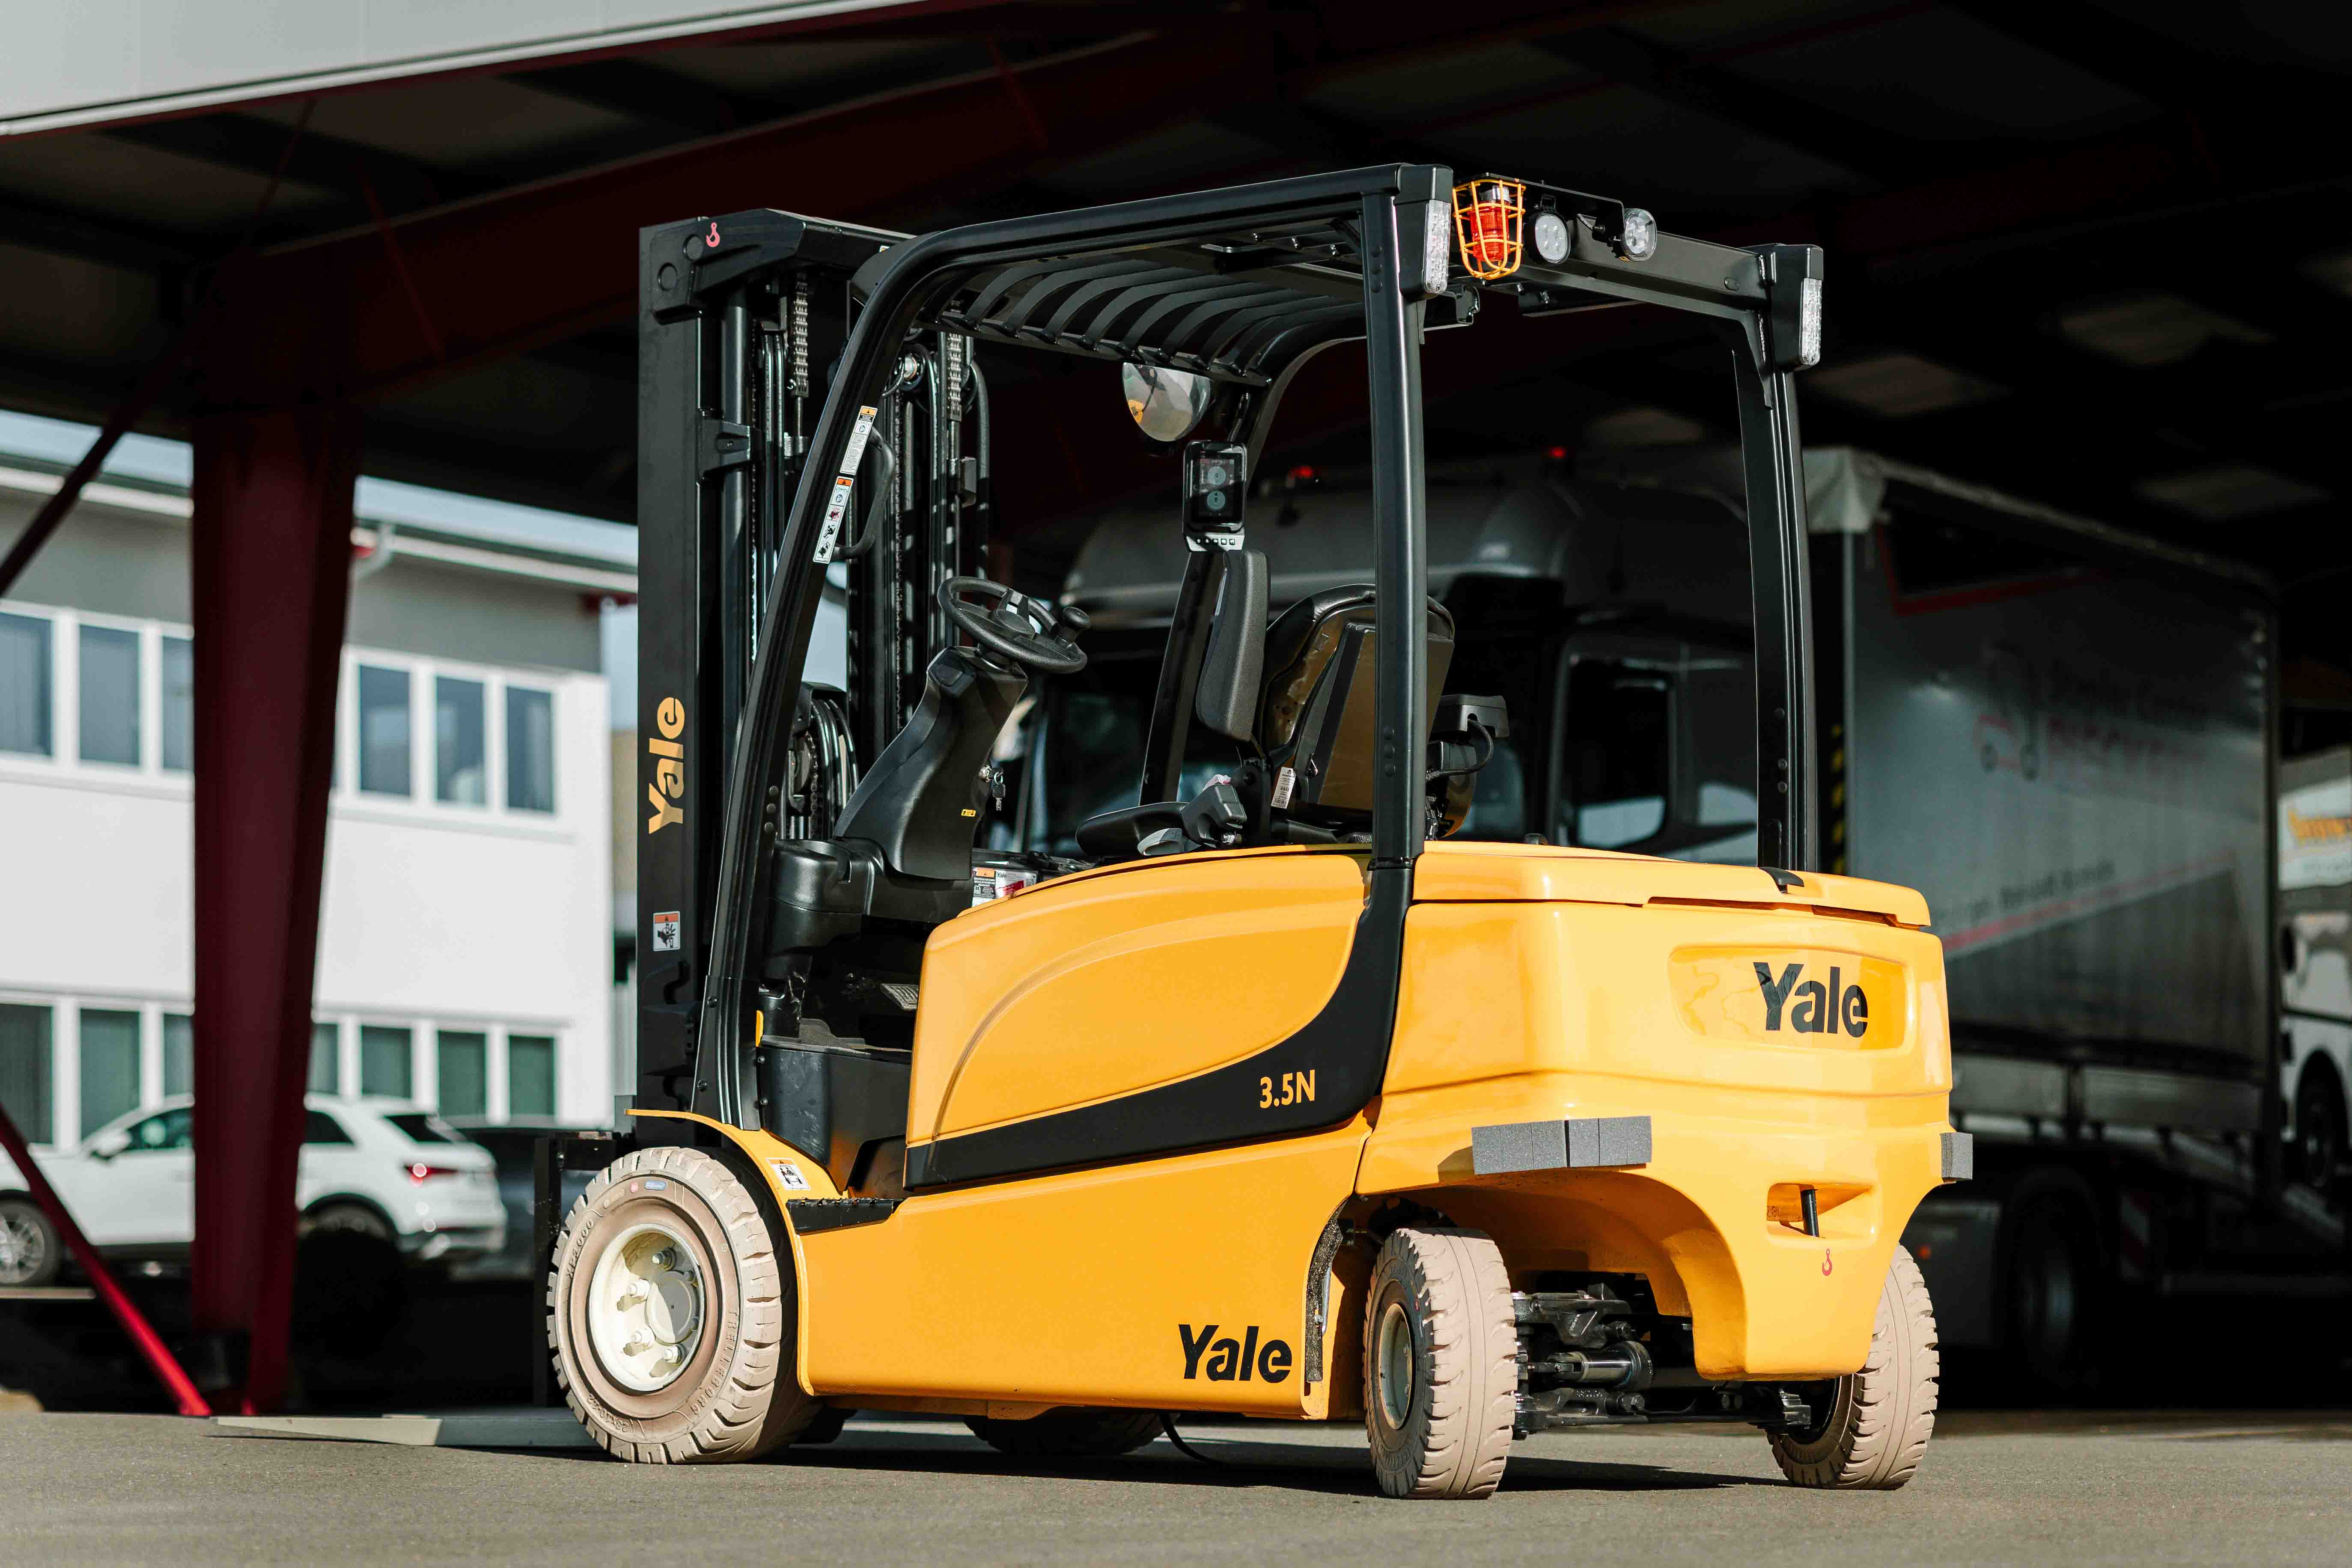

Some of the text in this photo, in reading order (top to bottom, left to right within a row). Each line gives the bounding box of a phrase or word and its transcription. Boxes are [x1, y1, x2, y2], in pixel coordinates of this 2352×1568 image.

[649, 697, 685, 834] Yale
[1753, 962, 1868, 1038] Yale
[1260, 1069, 1315, 1108] 3.5N
[690, 1311, 738, 1416] TRELLEBORG
[1178, 1324, 1292, 1383] Yale
